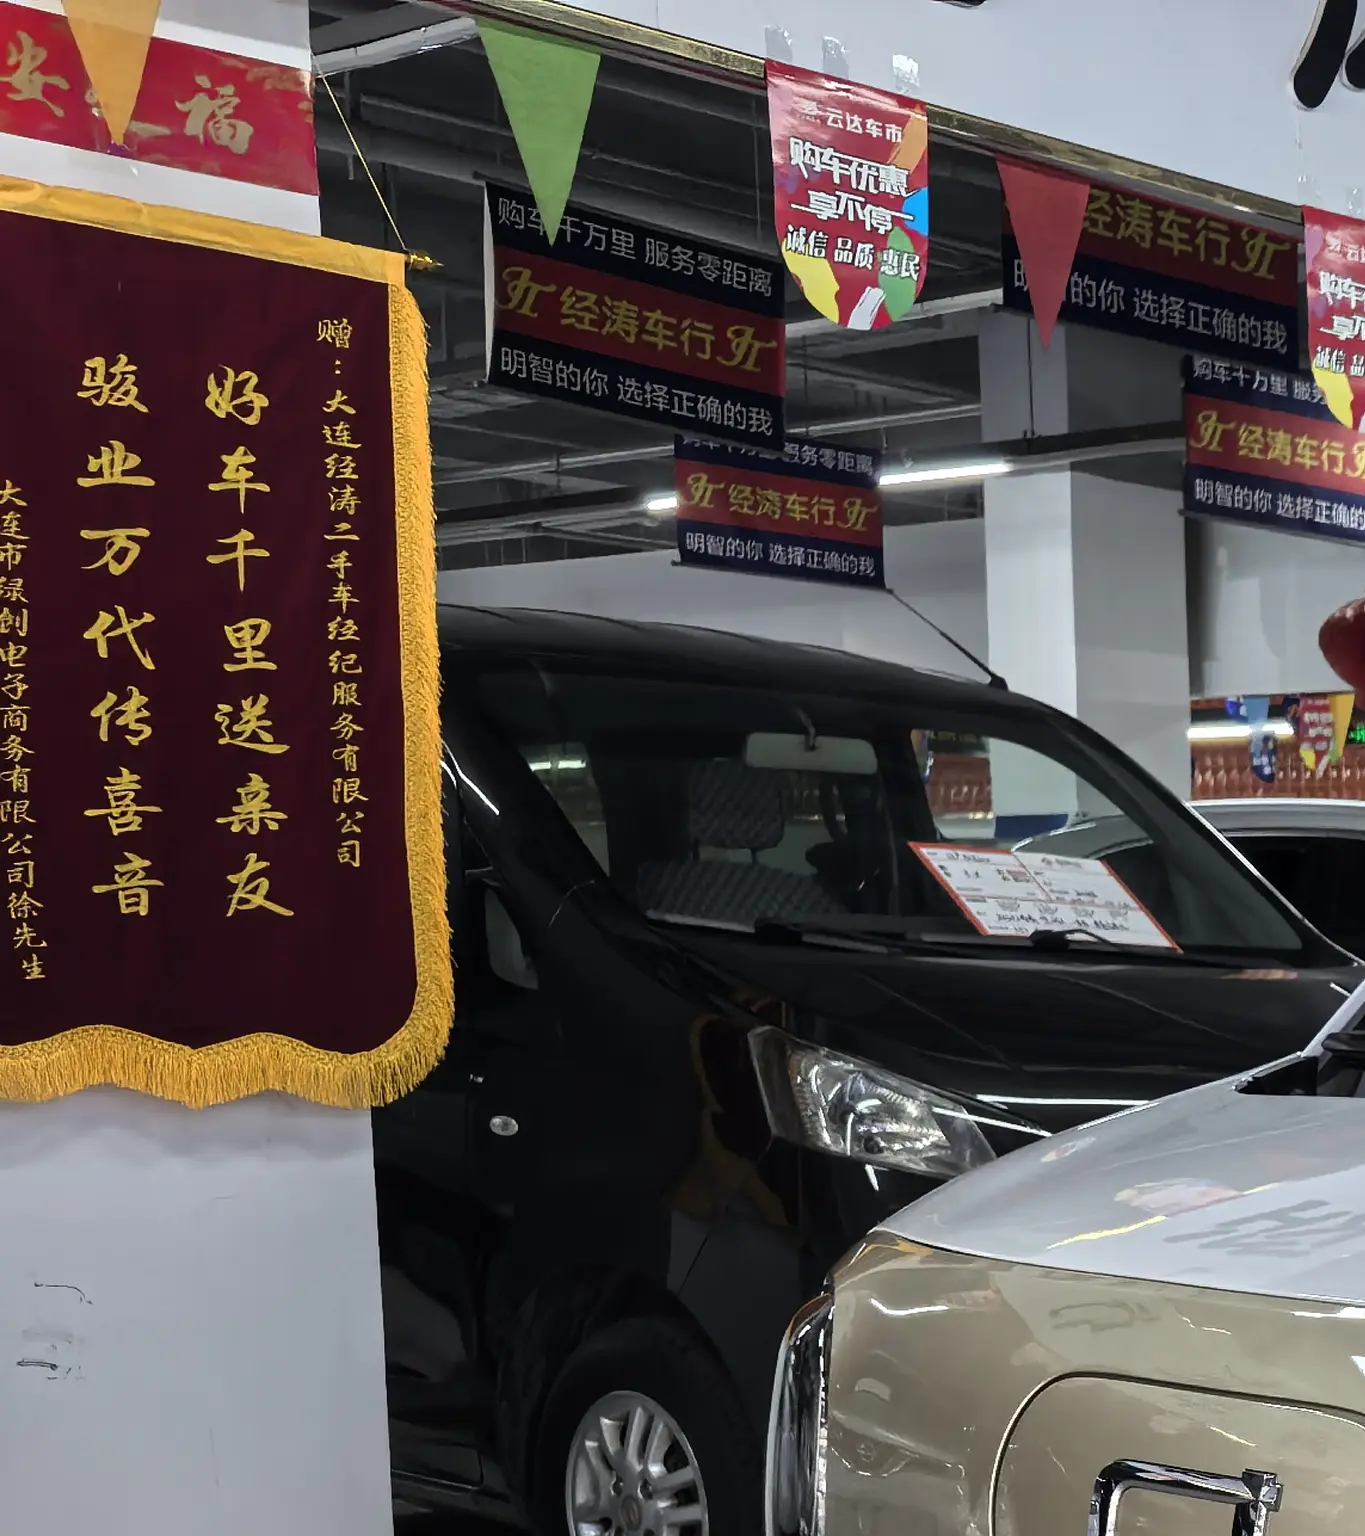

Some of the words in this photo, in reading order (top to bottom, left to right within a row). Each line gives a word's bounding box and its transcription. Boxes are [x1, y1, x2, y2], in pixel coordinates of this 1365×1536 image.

[789, 137, 911, 199] 购车优惠
[791, 190, 915, 235] 享不停
[645, 239, 773, 297] 服务零距离
[786, 224, 829, 259] 诚信
[834, 237, 874, 270] 品质
[881, 248, 921, 281] 惠民
[560, 286, 716, 361] 经涛车行
[1134, 287, 1288, 355] 选择正确的我
[501, 347, 609, 397] 明智的你
[618, 376, 773, 436] 选择正确的我
[1238, 422, 1345, 475] 经涛车行
[729, 484, 836, 527] 经涛车行
[1195, 478, 1272, 513] 明智的你
[77, 353, 165, 917] 骏业万代传喜音
